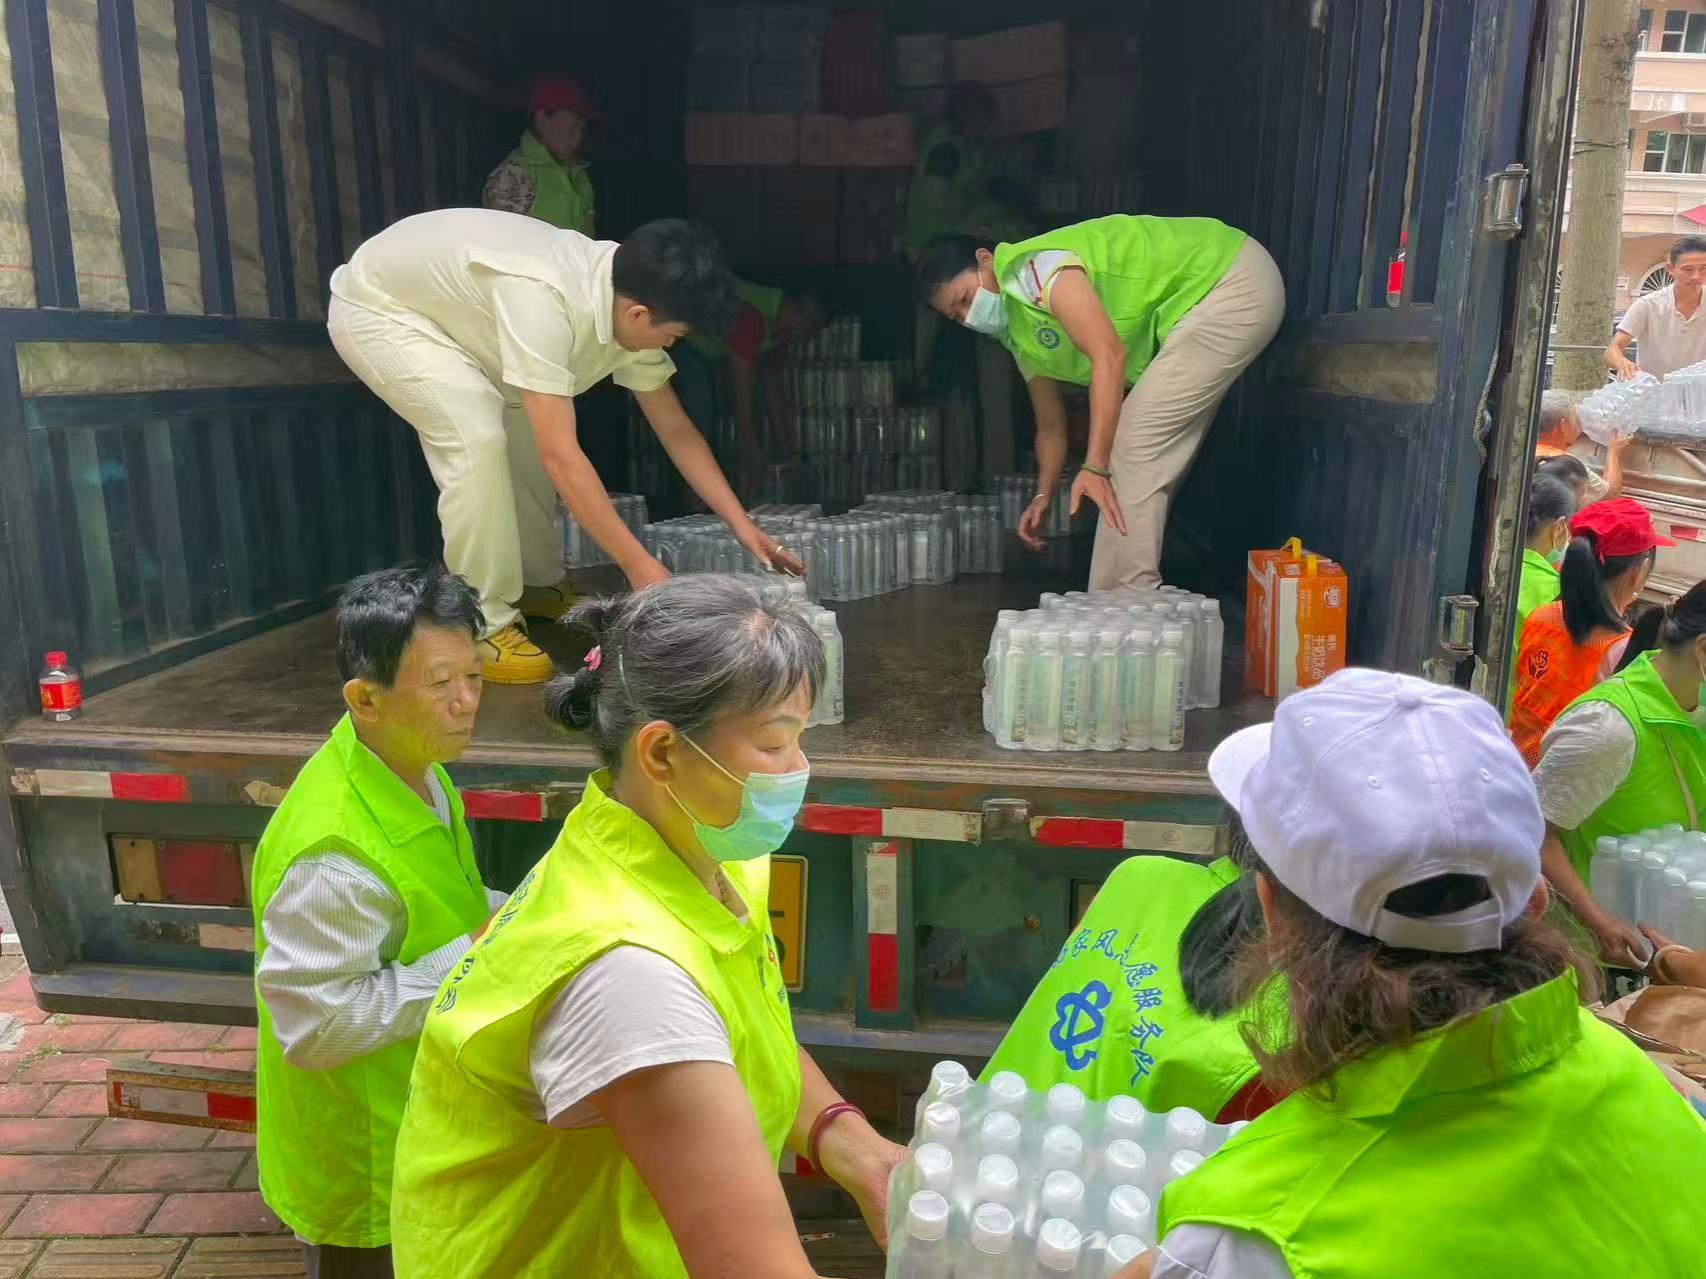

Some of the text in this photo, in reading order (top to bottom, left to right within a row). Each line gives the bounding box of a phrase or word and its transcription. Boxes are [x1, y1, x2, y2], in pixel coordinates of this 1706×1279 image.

[1312, 635, 1326, 680] 牛奶饮品
[1052, 929, 1164, 1088] 家风愿服务队
